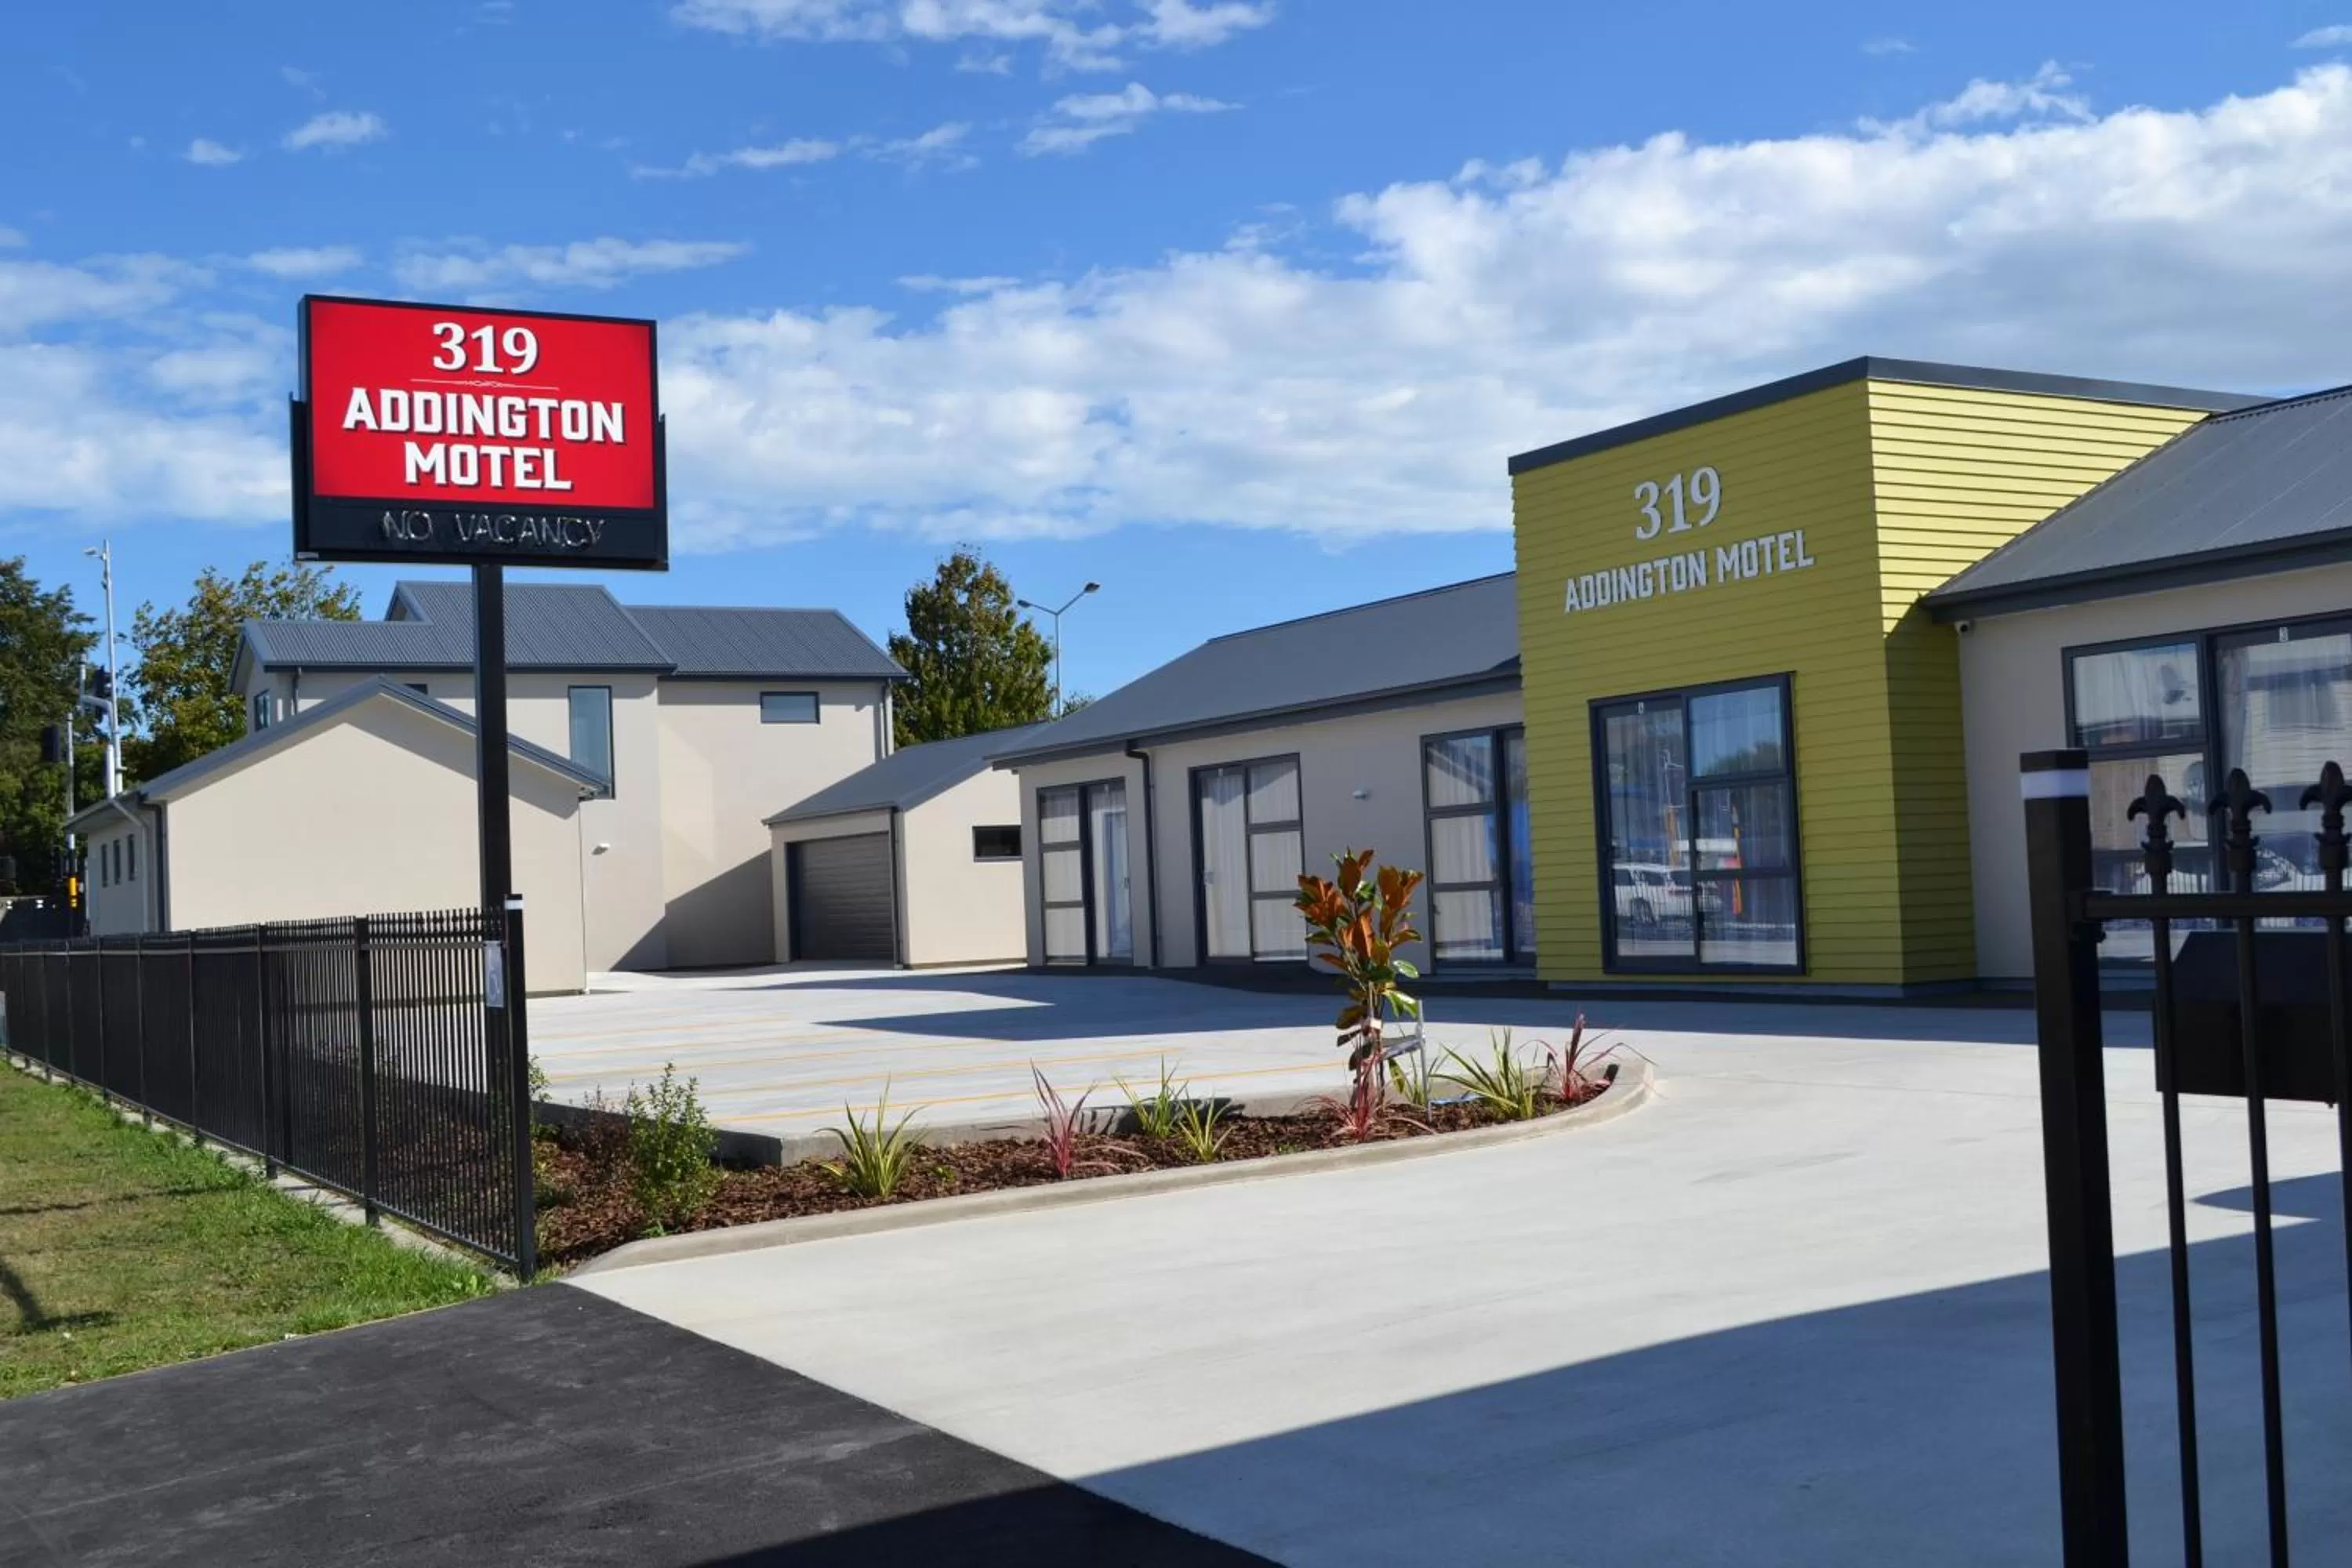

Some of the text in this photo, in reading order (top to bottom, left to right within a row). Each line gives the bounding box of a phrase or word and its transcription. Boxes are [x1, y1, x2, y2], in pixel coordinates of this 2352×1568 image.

[430, 321, 539, 374] 319
[342, 387, 625, 443] ADDINGTON
[404, 441, 573, 490] MOTEL
[381, 510, 604, 547] NO VACANCY
[1633, 466, 1722, 540] 319
[1564, 529, 1816, 614] ADDINGTON MOTEL
